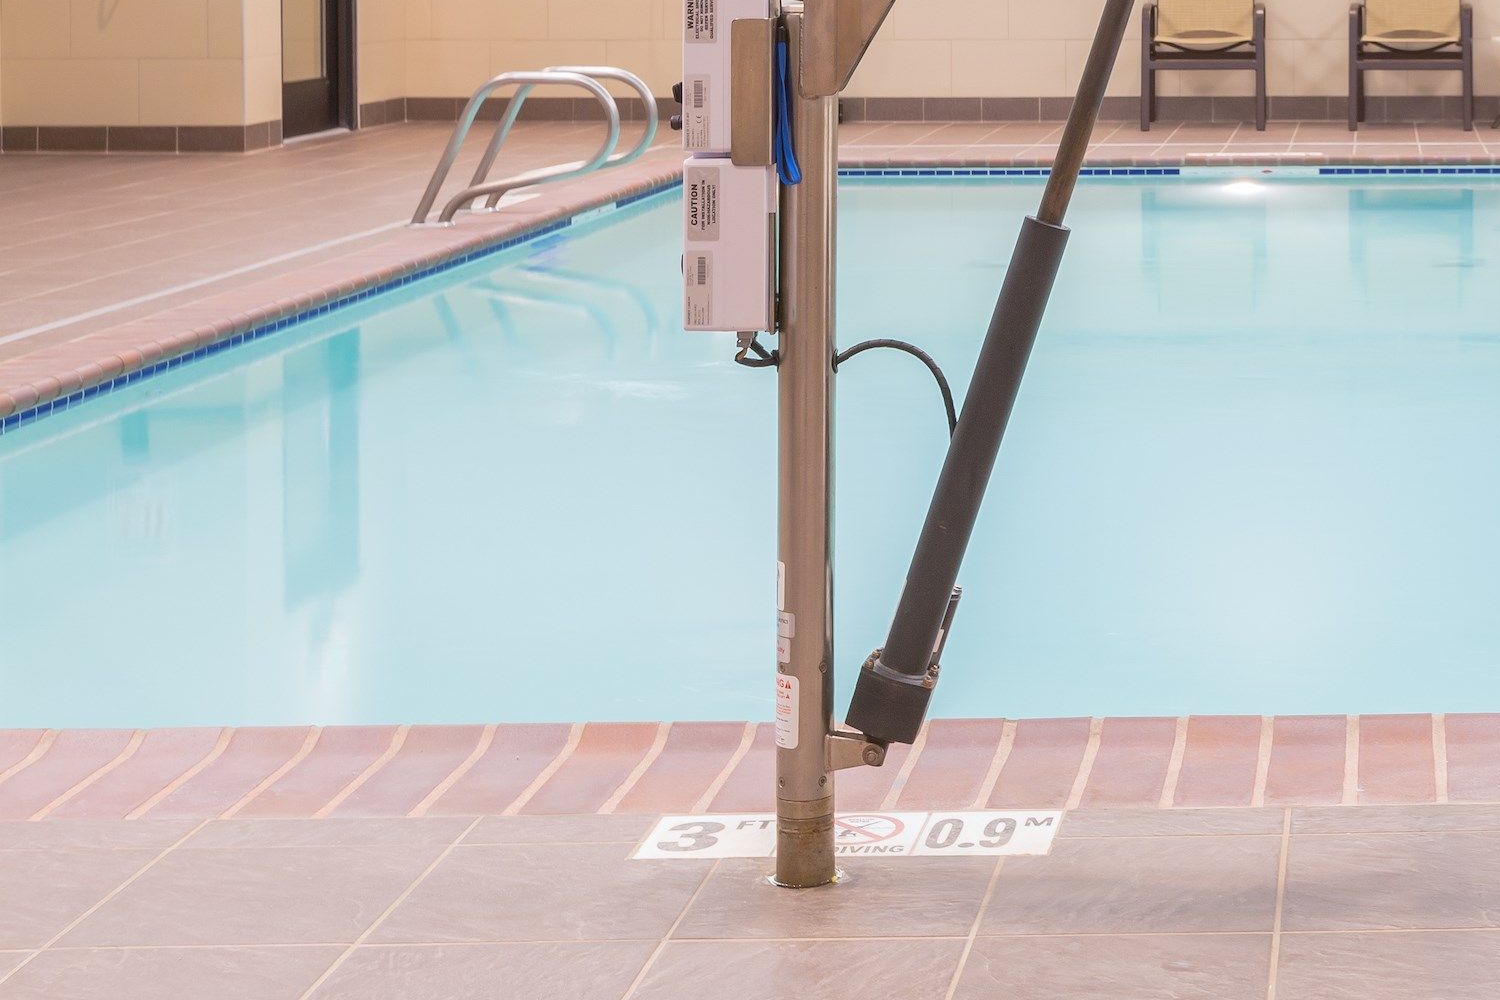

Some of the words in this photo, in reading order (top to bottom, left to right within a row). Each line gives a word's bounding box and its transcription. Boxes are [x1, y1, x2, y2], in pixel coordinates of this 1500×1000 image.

[690, 184, 698, 226] CAUTION
[656, 820, 727, 852] 3
[735, 819, 777, 830] FT
[925, 817, 1018, 848] 0.9
[1024, 816, 1055, 827] M
